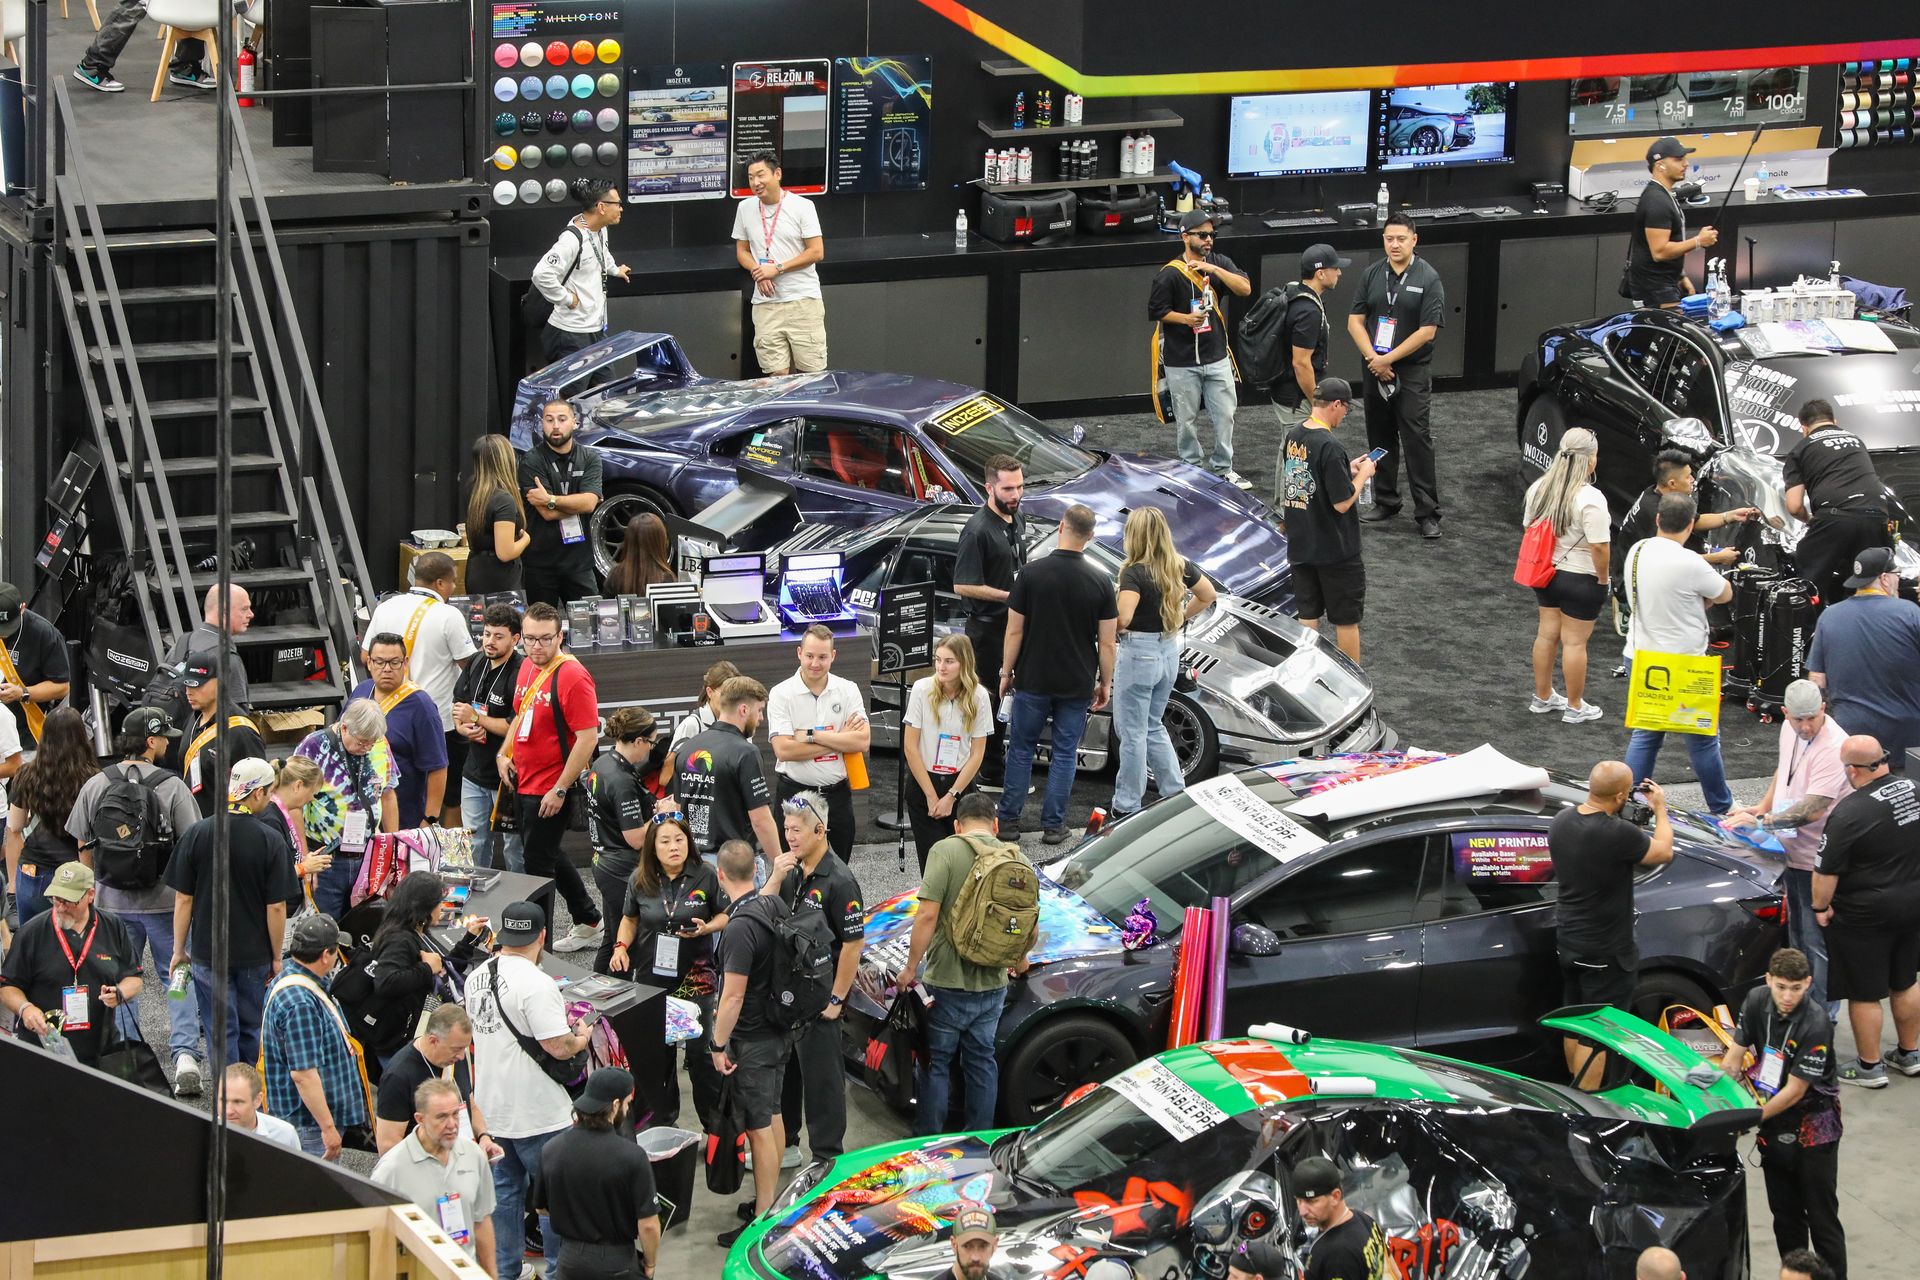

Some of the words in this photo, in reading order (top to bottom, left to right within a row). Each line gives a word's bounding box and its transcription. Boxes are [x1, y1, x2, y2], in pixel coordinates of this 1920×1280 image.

[546, 11, 619, 23] MILLIOTONE
[805, 71, 815, 81] IR
[1663, 101, 1686, 115] 8.5
[1722, 97, 1744, 111] 7.5
[1765, 92, 1805, 110] 100+
[1604, 104, 1627, 118] 7.5
[1671, 112, 1686, 121] mil
[1730, 108, 1744, 118] mil
[1780, 107, 1803, 115] colors
[1611, 115, 1626, 125] mil
[1748, 364, 1798, 388] SHOW
[1742, 374, 1784, 398] YOUR
[1733, 386, 1775, 408] SKILL
[1232, 798, 1277, 830] PRINTABLE
[1271, 824, 1297, 840] PPF
[1469, 838, 1496, 848] NEW
[1148, 1075, 1194, 1115] PRINTABLE
[827, 1211, 854, 1235] Printable
[847, 1231, 867, 1245] PPF
